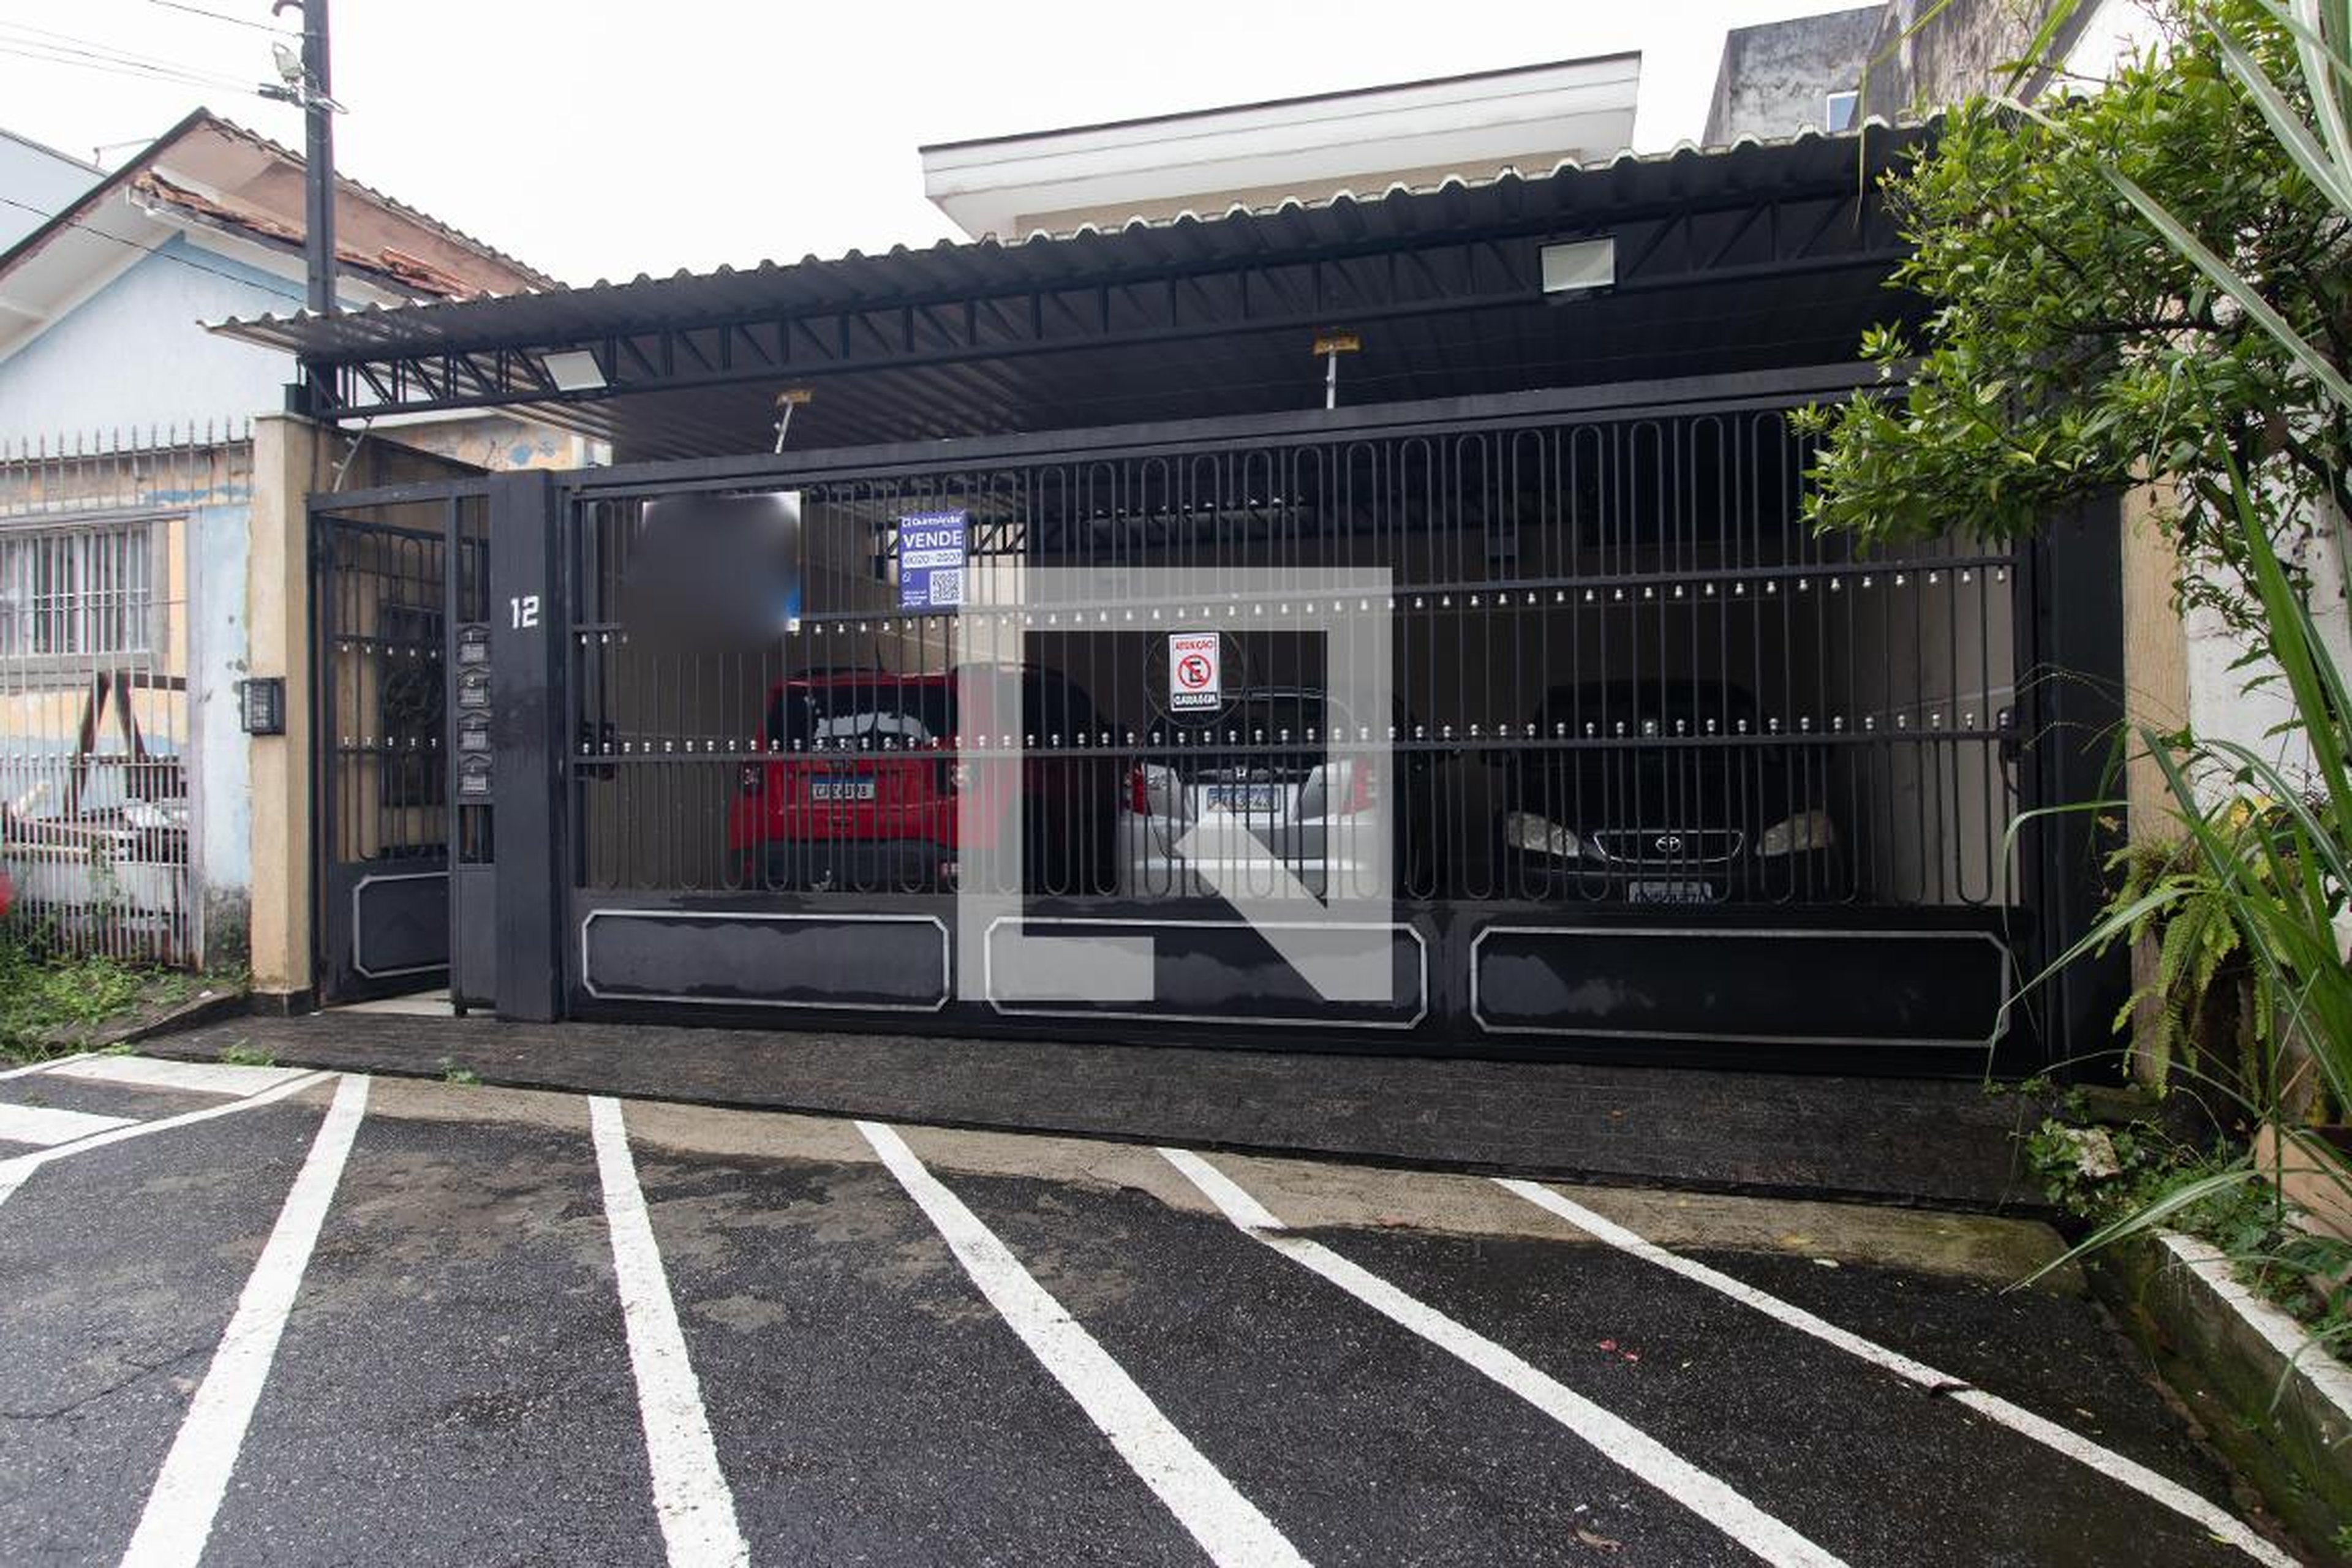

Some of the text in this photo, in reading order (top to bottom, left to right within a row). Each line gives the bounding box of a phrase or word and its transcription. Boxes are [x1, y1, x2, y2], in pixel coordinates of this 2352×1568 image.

[903, 530, 963, 548] VENDE
[510, 595, 540, 630] 12
[1174, 693, 1217, 706] GARAGEM
